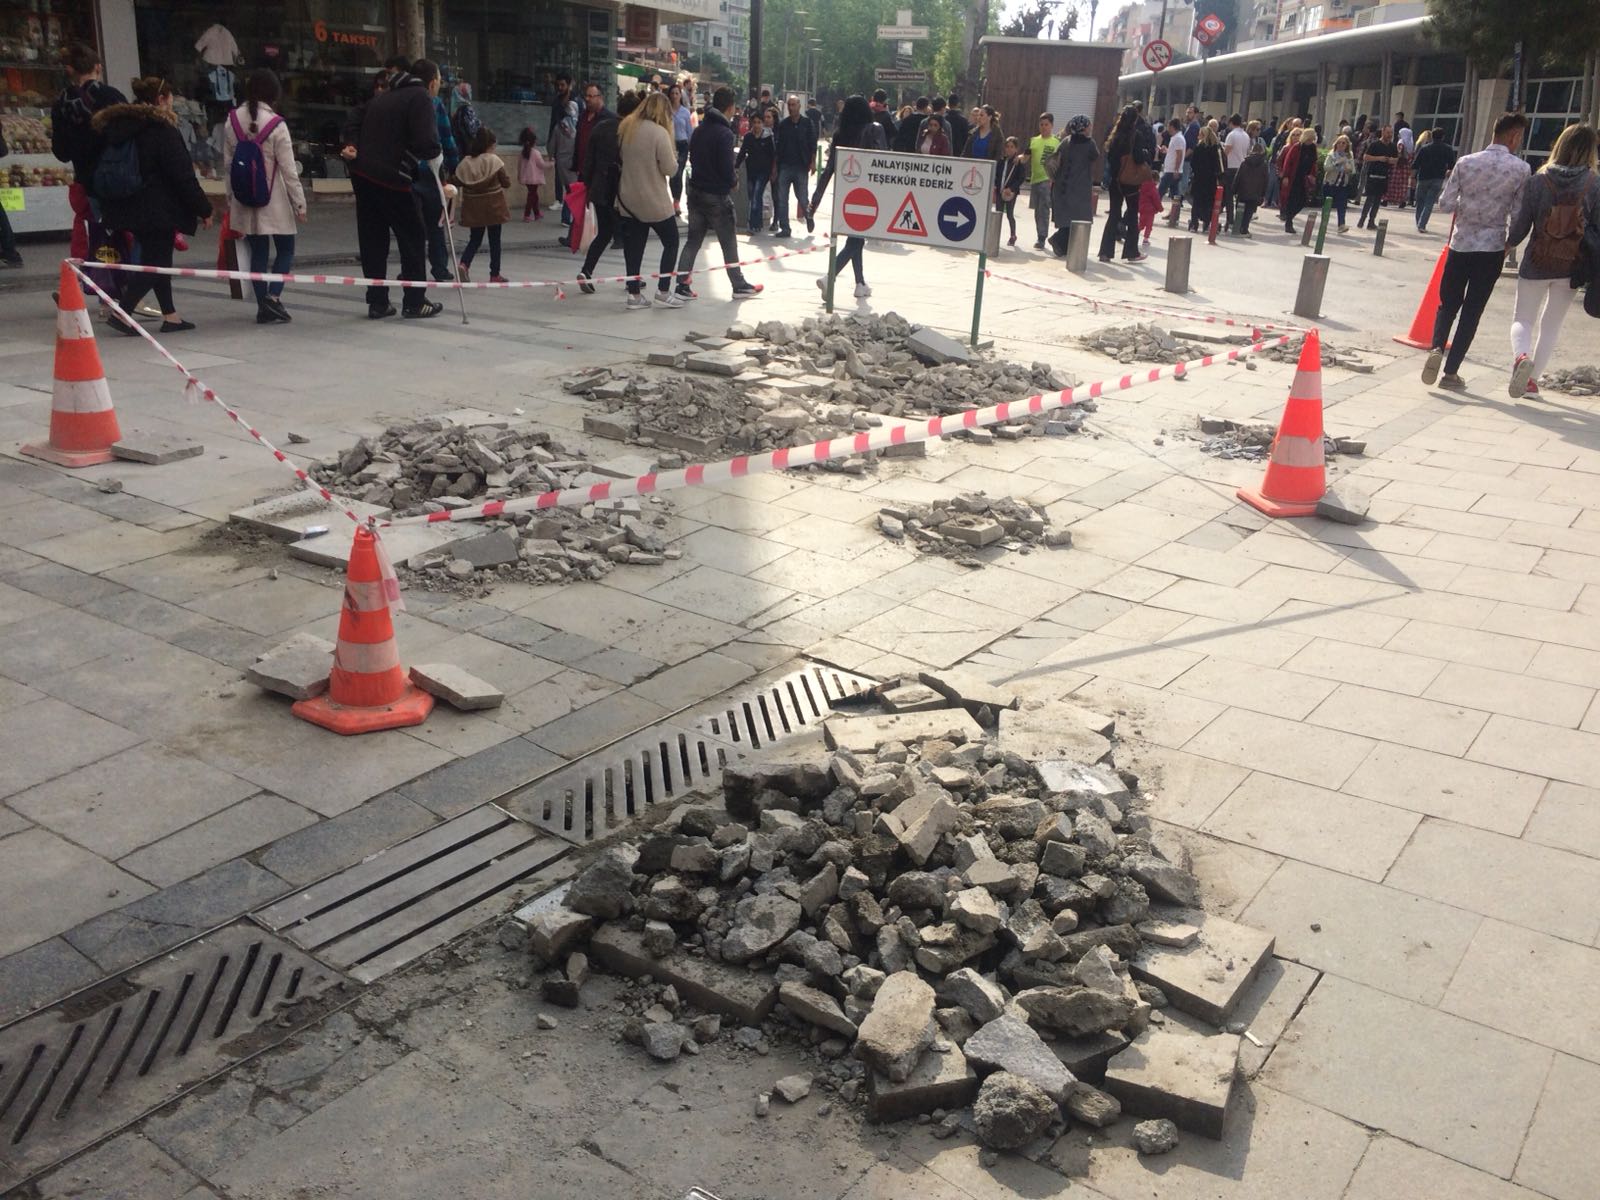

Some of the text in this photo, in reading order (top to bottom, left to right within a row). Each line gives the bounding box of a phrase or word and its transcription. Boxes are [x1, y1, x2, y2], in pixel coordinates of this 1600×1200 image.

[314, 19, 328, 42] 6
[871, 158, 953, 176] ANLAYIŞINIZ İÇİN
[867, 173, 954, 190] TEŞEKKÜR EDERİZ
